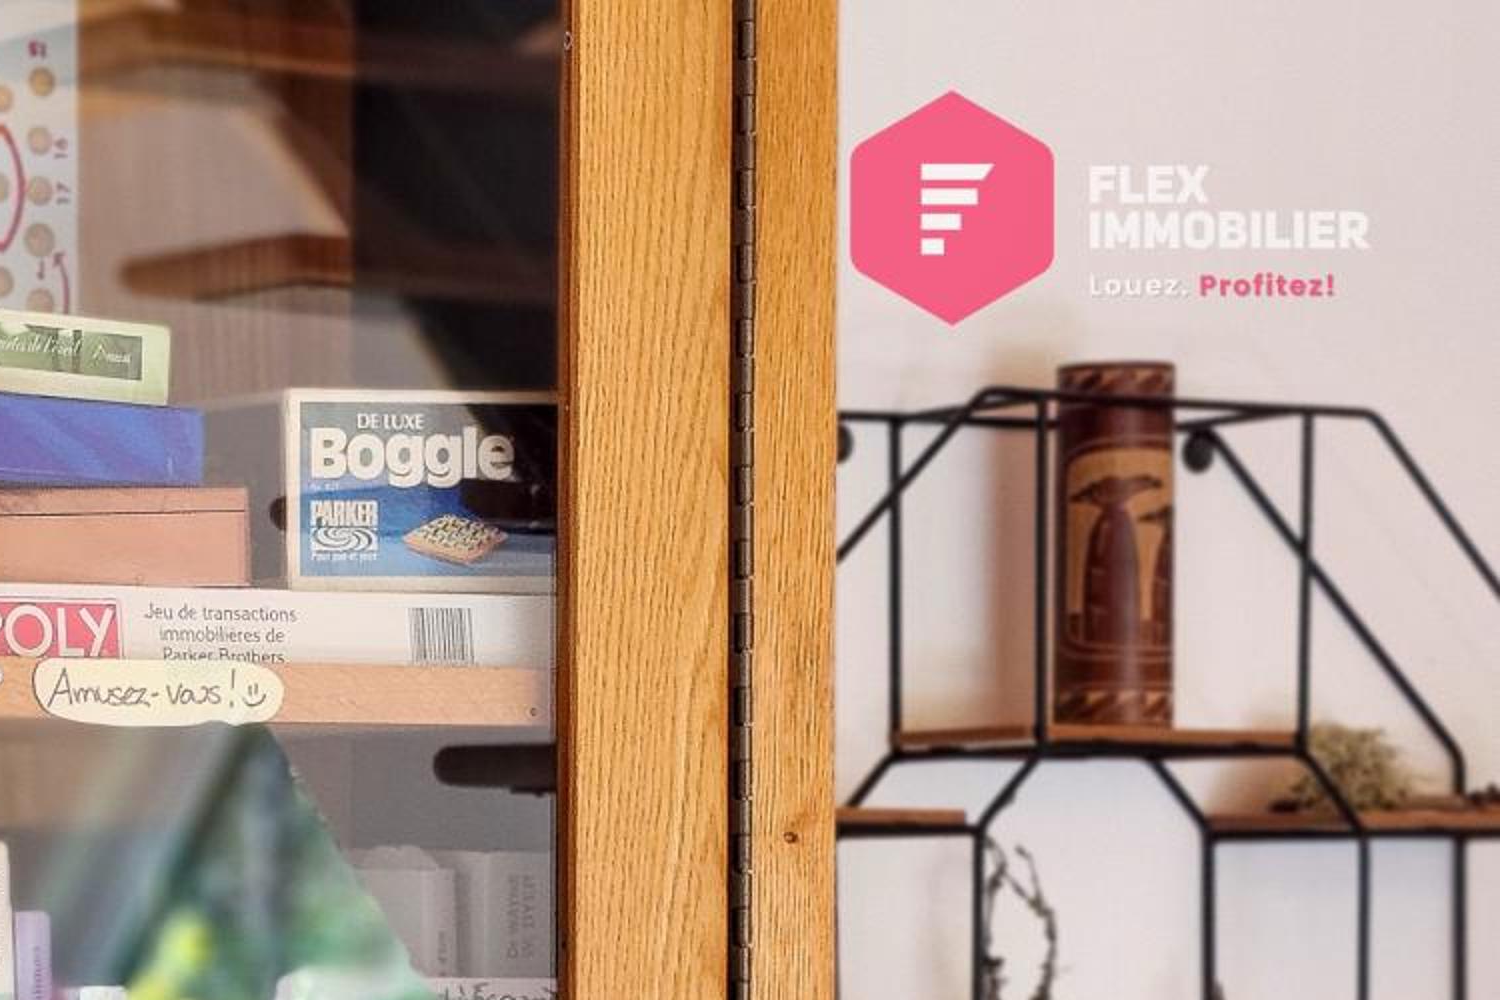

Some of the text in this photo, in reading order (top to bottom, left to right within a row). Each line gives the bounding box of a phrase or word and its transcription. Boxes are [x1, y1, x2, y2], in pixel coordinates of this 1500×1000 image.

[357, 413, 425, 430] DE LUXE
[310, 425, 516, 488] Boggle
[311, 500, 378, 527] PARKER
[144, 601, 298, 623] Jeu de transactions
[265, 627, 286, 643] de
[219, 647, 287, 665] Brothers
